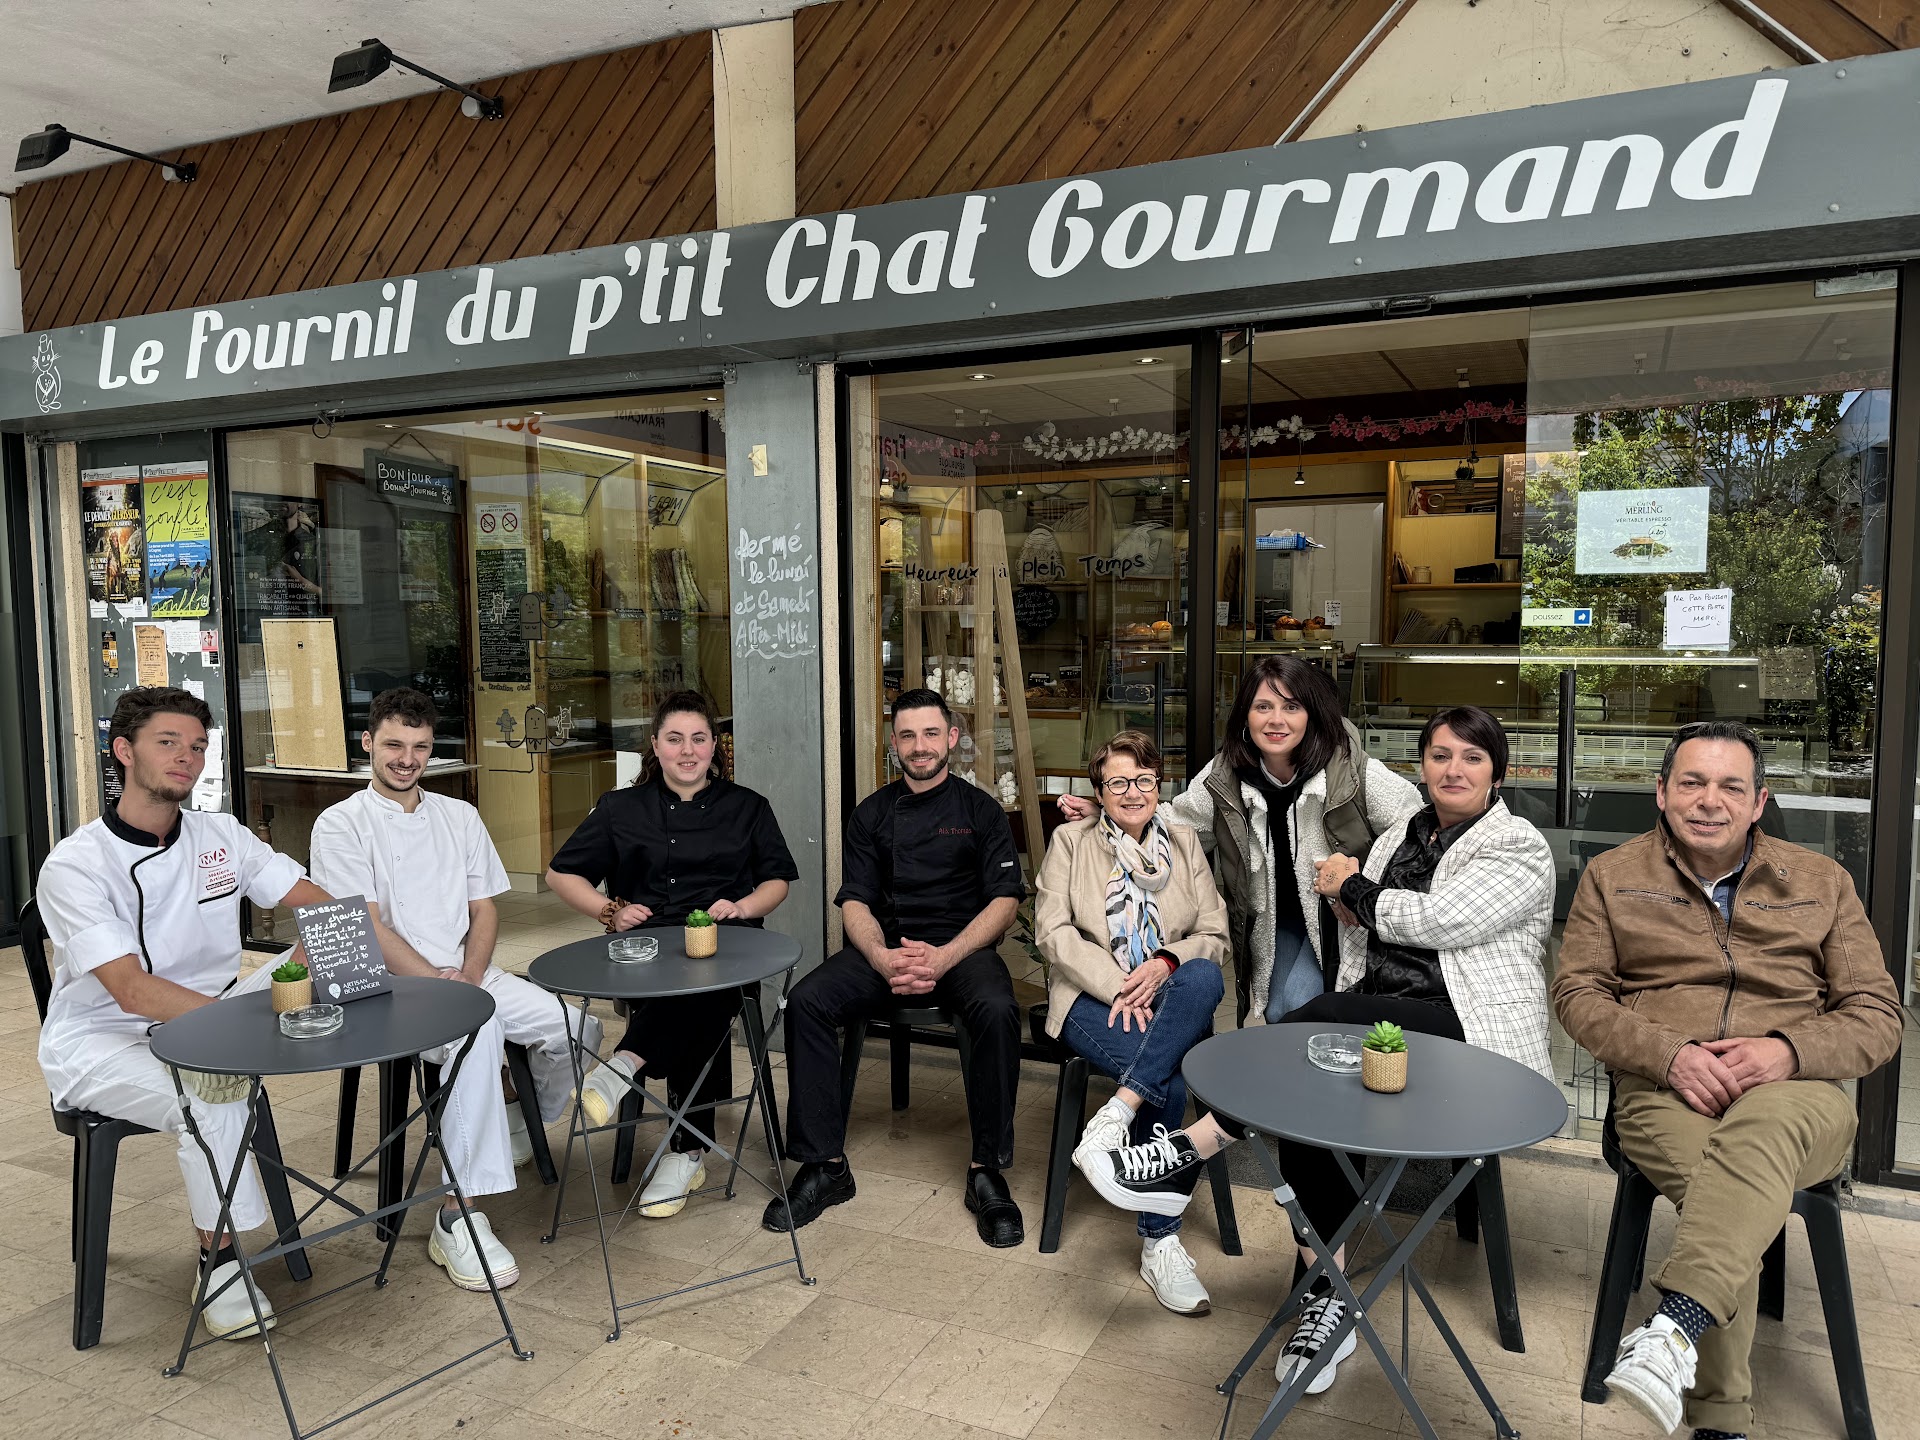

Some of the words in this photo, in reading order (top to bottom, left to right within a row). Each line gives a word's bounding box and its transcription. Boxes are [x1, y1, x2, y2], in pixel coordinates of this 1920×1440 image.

[98, 325, 163, 390] Le
[185, 279, 418, 380] fournil
[445, 267, 538, 346] du
[568, 232, 732, 355] p'tit
[765, 195, 988, 308] Chat
[1027, 78, 1789, 278] Gourmand
[1624, 506, 1663, 515] MERLING
[748, 560, 766, 584] le
[905, 563, 978, 582] Heureux
[997, 563, 1007, 578] à
[1022, 556, 1065, 582] plein
[1079, 555, 1145, 578] Temps
[734, 591, 755, 615] et
[757, 586, 815, 620] Samedi
[1673, 594, 1685, 603] Ne
[1532, 614, 1563, 623] poussez
[297, 903, 345, 919] Boisson
[328, 907, 367, 924] chaude
[315, 955, 352, 972] Chocolat
[317, 969, 336, 981] Thé
[342, 978, 368, 988] ARTISAN
[343, 981, 381, 995] BOULANGER
